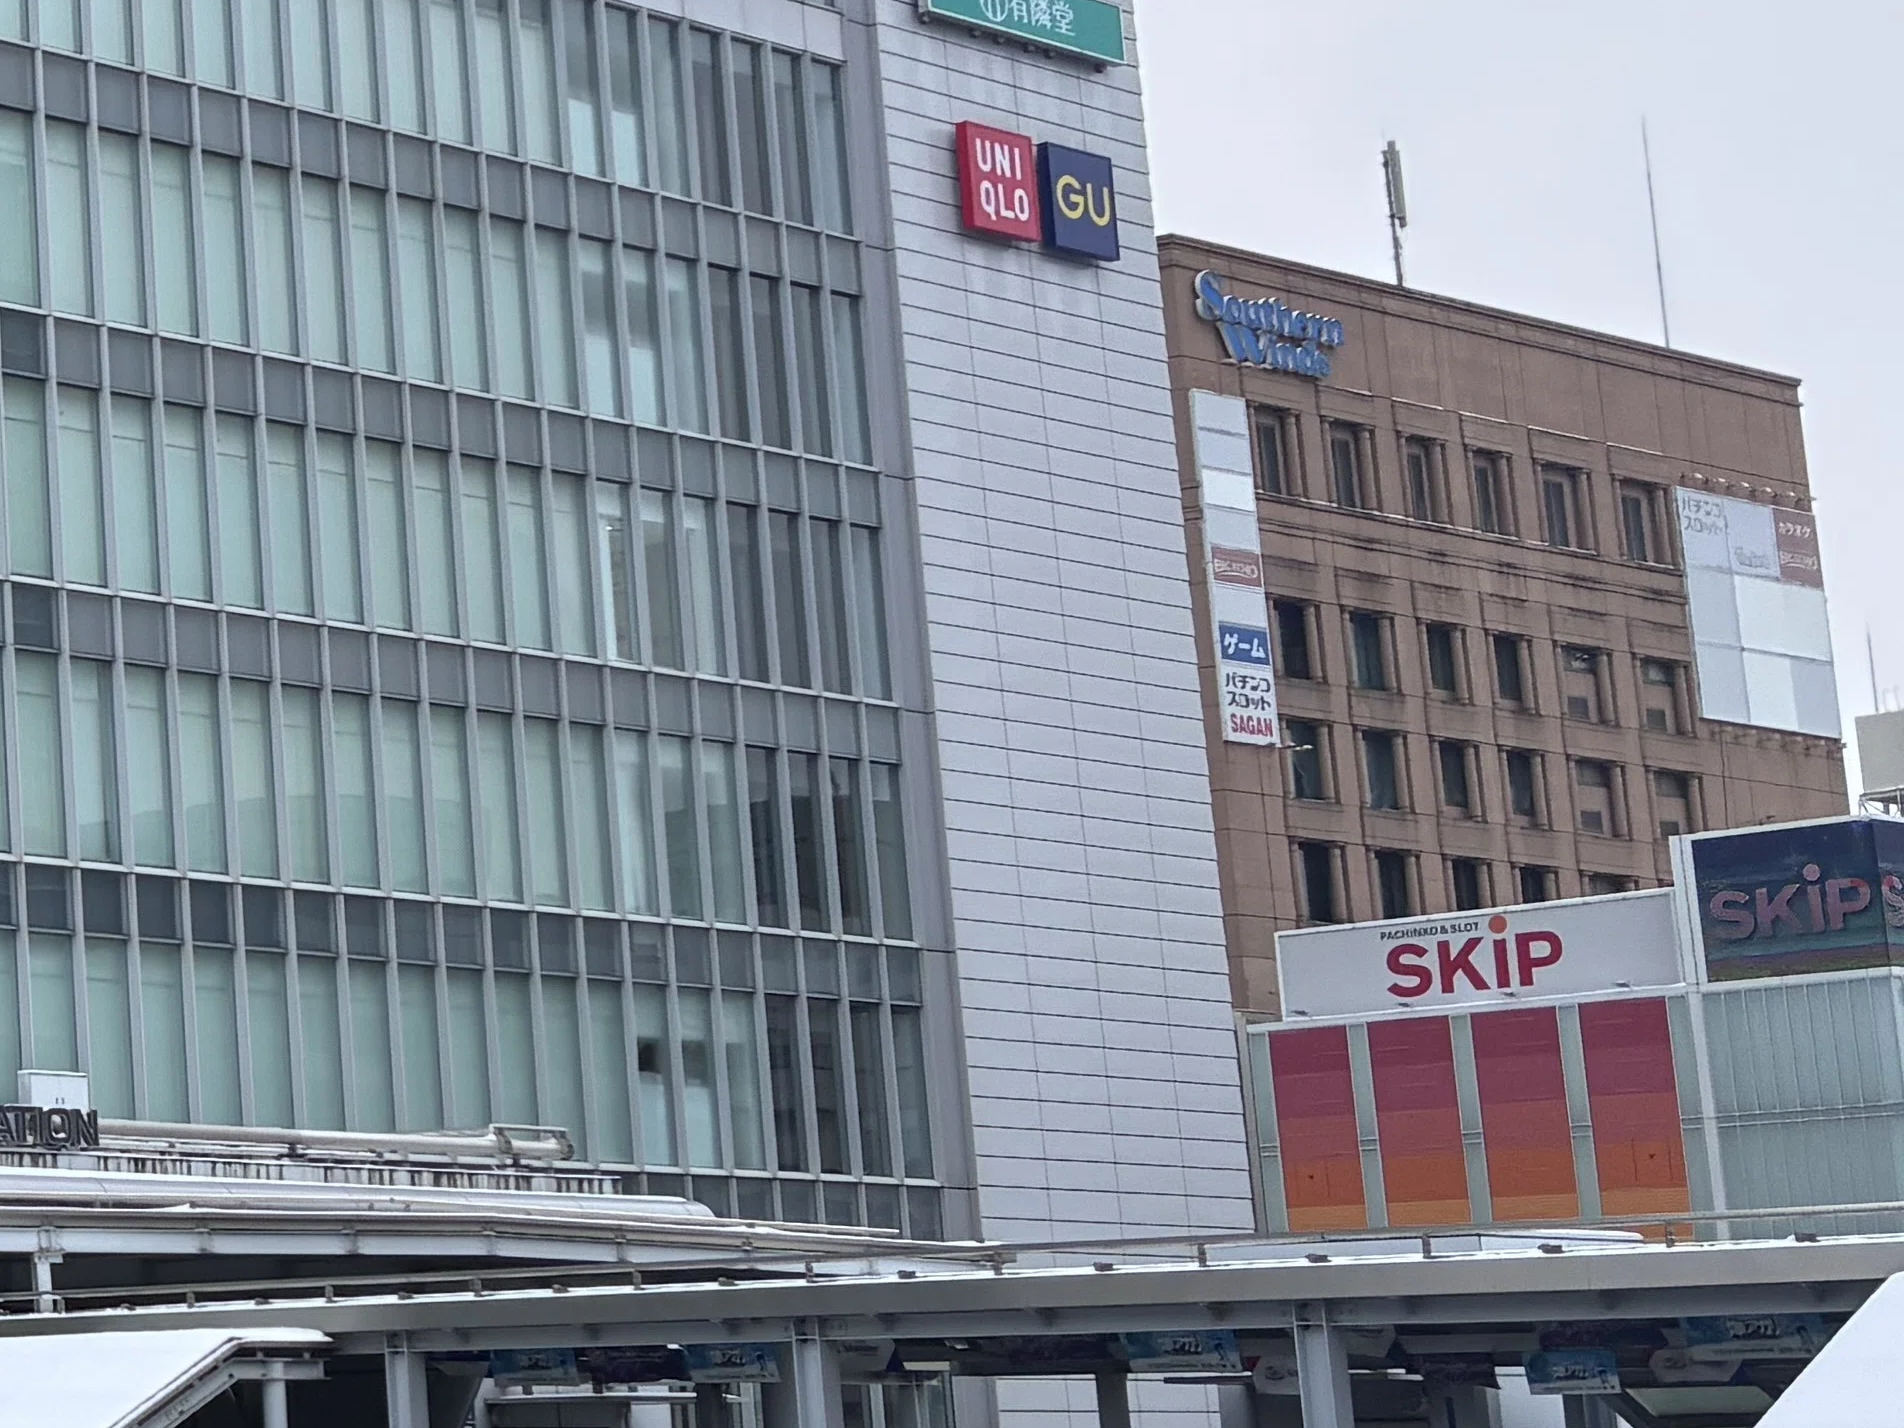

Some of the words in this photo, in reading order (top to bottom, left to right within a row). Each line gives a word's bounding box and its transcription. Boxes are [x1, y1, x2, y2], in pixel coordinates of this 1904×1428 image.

[975, 138, 1022, 180] UNI
[980, 180, 1030, 222] QLO
[1056, 174, 1111, 227] GU
[1194, 269, 1344, 348] Southern
[1216, 321, 1332, 380] Winds
[1223, 633, 1267, 659] ゲーム
[1225, 672, 1271, 694] パチンコ
[1226, 691, 1272, 712] スロット
[1230, 713, 1274, 738] SAGAN
[1380, 926, 1438, 941] PACHINKO
[1450, 922, 1480, 934] SLOT
